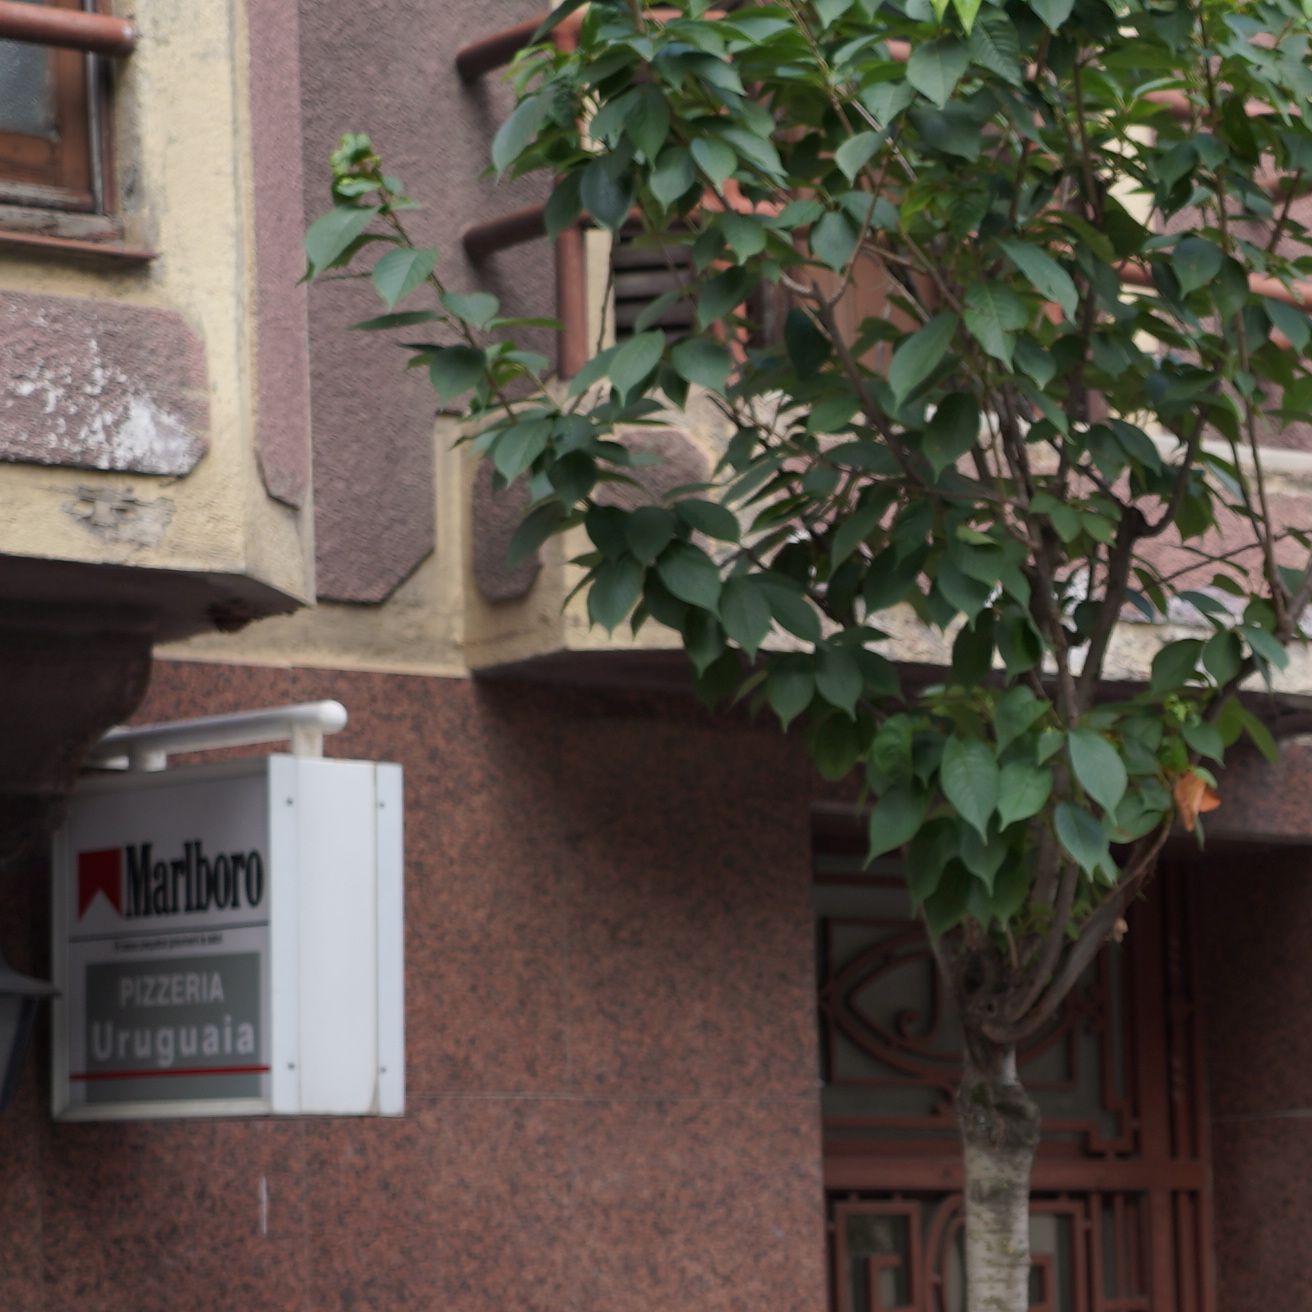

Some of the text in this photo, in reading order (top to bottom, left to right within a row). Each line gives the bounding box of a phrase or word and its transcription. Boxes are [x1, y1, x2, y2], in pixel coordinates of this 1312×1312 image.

[125, 840, 264, 918] Marlboro
[120, 971, 224, 1007] PIZZERIA
[93, 1015, 255, 1066] Uruguaia
